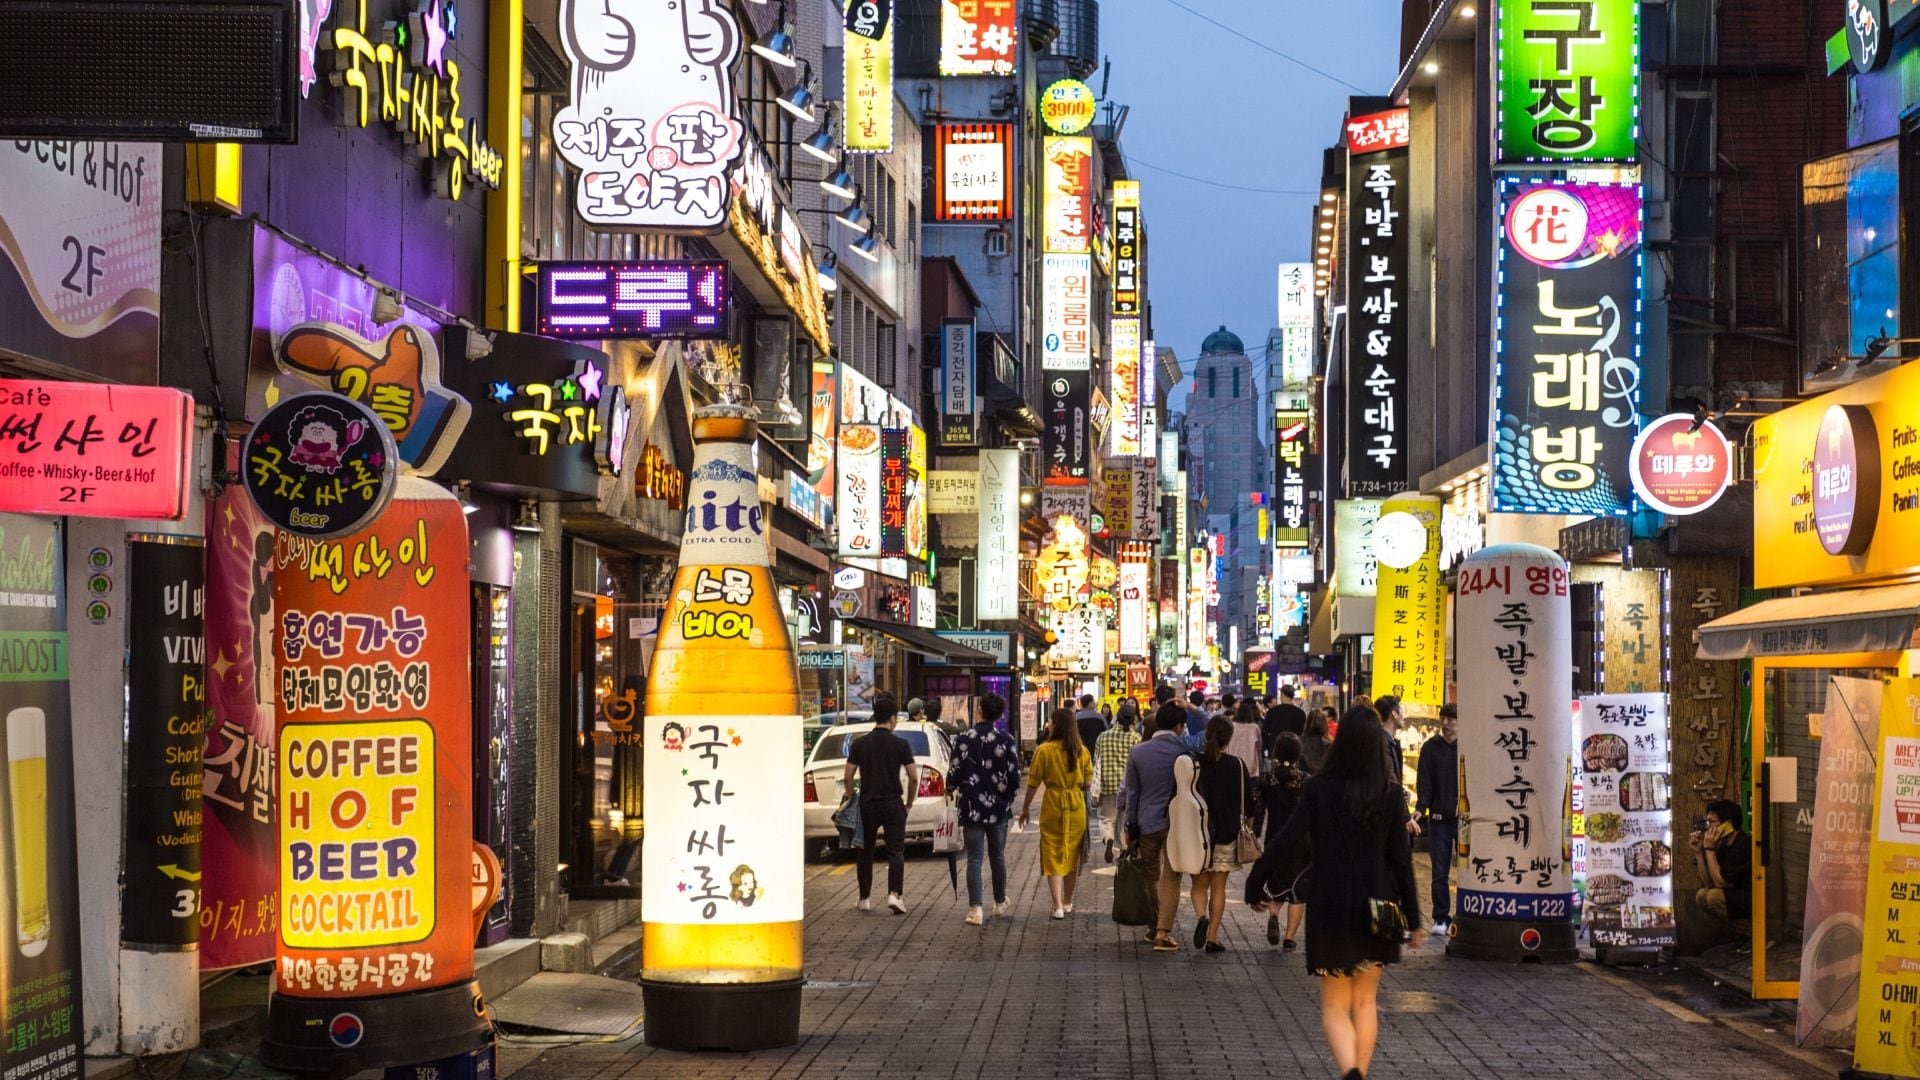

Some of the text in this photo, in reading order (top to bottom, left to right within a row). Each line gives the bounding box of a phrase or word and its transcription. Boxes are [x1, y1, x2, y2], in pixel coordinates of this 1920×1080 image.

[952, 24, 1014, 56] 포차
[1524, 1, 1606, 151] 구장
[471, 117, 503, 190] beer
[559, 110, 728, 168] 제주 판
[585, 170, 723, 219] 도야지
[1524, 205, 1572, 245] 花
[61, 236, 106, 297] 2F
[1061, 275, 1088, 354] 원룸텔
[951, 326, 967, 414] 종각전자담배
[1046, 357, 1062, 367] 722
[1531, 279, 1604, 491] 노래방
[510, 383, 602, 456] 국자
[1893, 427, 1917, 449] Fruits
[59, 486, 97, 503] 2F
[1107, 482, 1130, 523] 부동산
[289, 510, 329, 529] beer
[686, 535, 752, 546] EXTRA COLD
[1053, 550, 1076, 605] 주막
[1460, 565, 1567, 597] 24시 영업
[282, 606, 428, 662] 흡연가능
[282, 662, 430, 713] 단체모임환영
[1132, 671, 1148, 684] W
[289, 736, 419, 779] COFFEE
[688, 724, 736, 920] 국자싸롱
[289, 838, 418, 882] BEER
[288, 889, 420, 935] COCKTAIL
[1463, 894, 1565, 918] 02)734-1222
[1887, 907, 1899, 922] M
[1886, 929, 1906, 944] XL
[1879, 1009, 1891, 1023] M
[1878, 1031, 1897, 1047] XL
